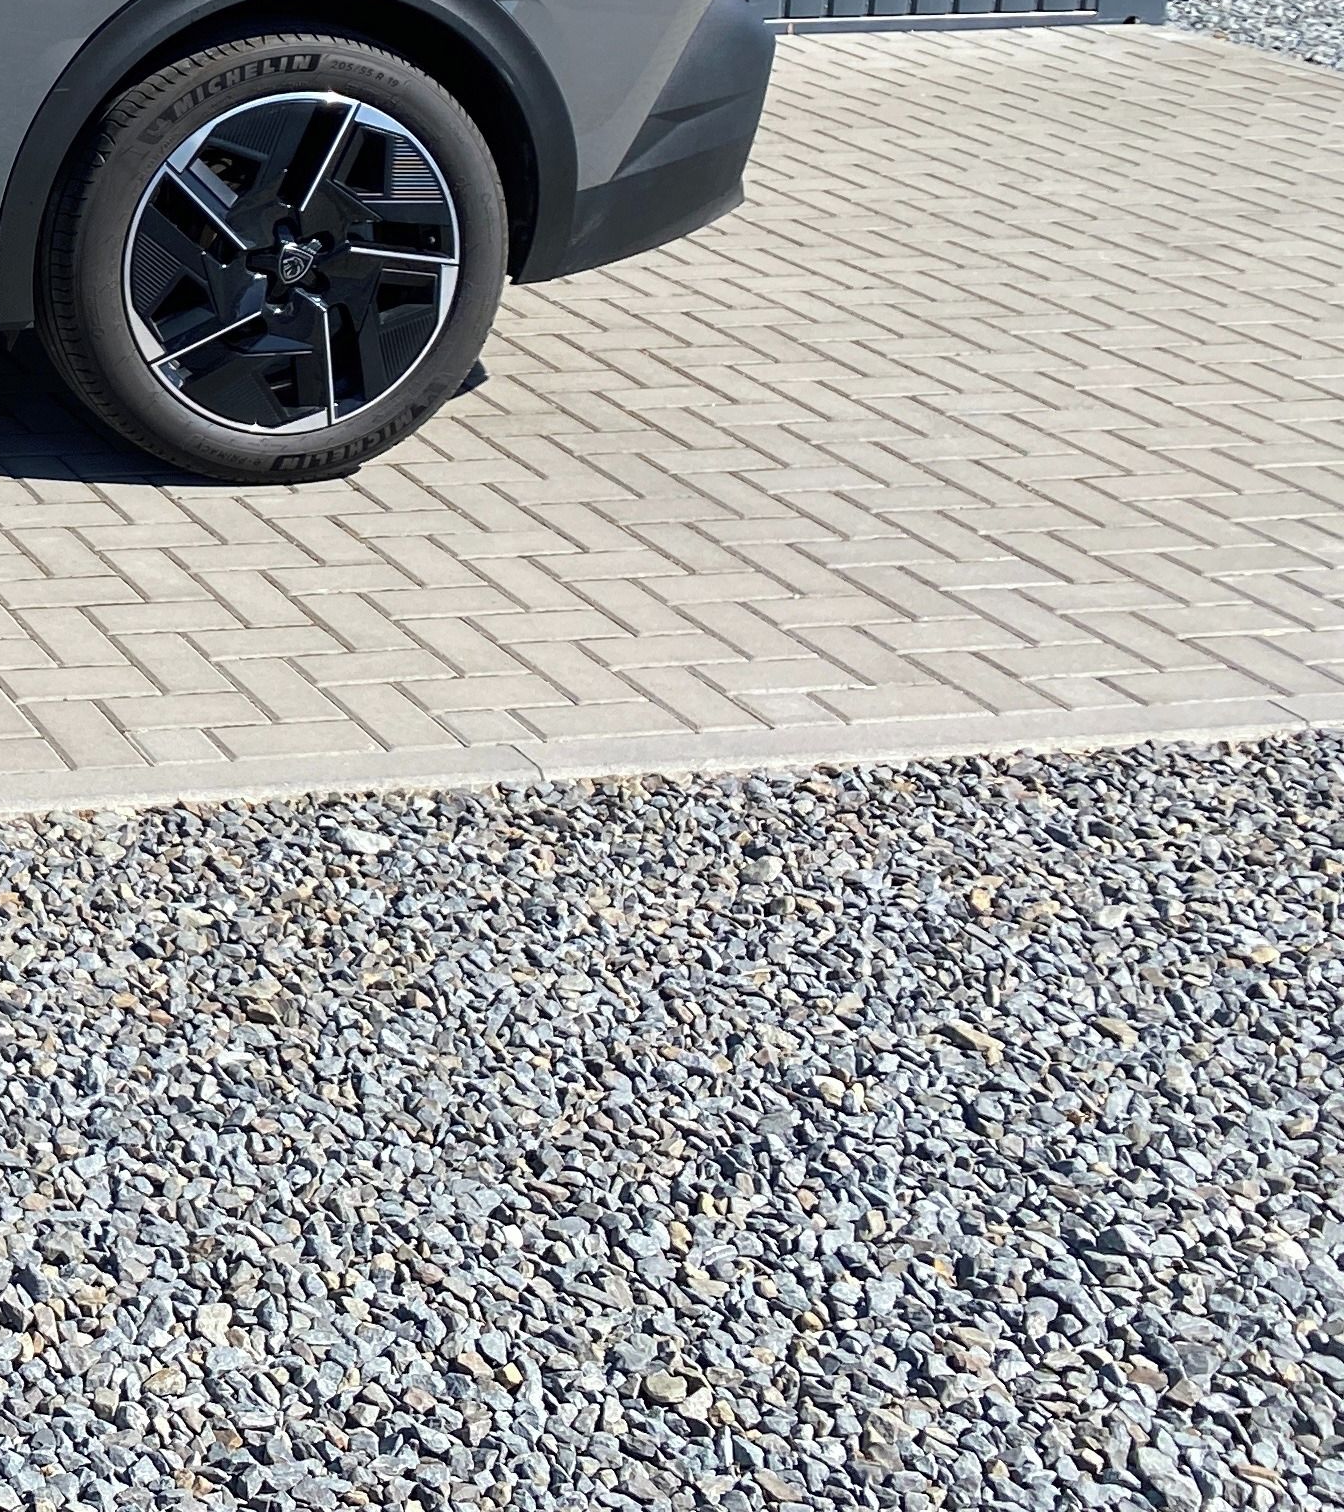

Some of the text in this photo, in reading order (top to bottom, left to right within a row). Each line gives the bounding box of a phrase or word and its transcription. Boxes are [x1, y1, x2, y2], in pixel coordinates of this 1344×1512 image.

[173, 55, 312, 119] MICHELIN
[329, 60, 400, 87] 205/55 R 19
[280, 412, 415, 472] MICHELIN
